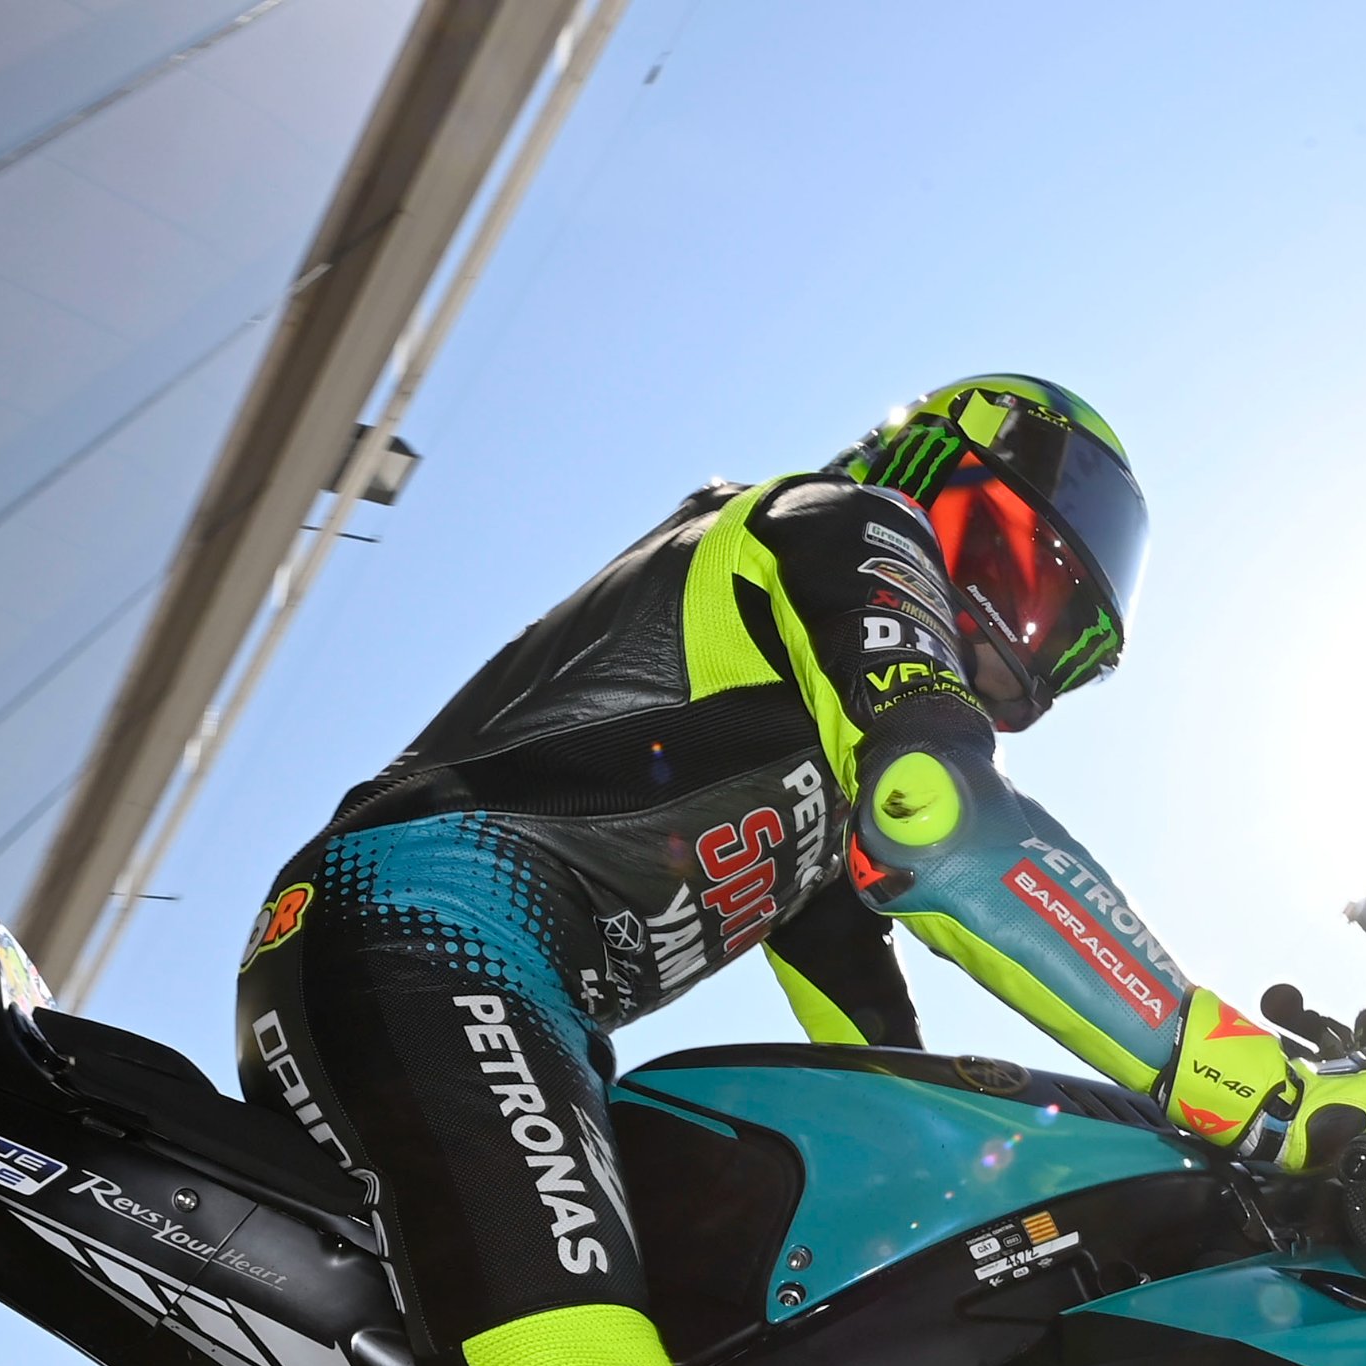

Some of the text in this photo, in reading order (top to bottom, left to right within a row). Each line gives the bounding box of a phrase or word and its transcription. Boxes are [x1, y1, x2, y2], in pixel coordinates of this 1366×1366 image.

[1014, 871, 1164, 1020] BARRACUDA
[453, 995, 609, 1275] PETRONAS
[68, 1169, 288, 1286] Revs Your Heart
